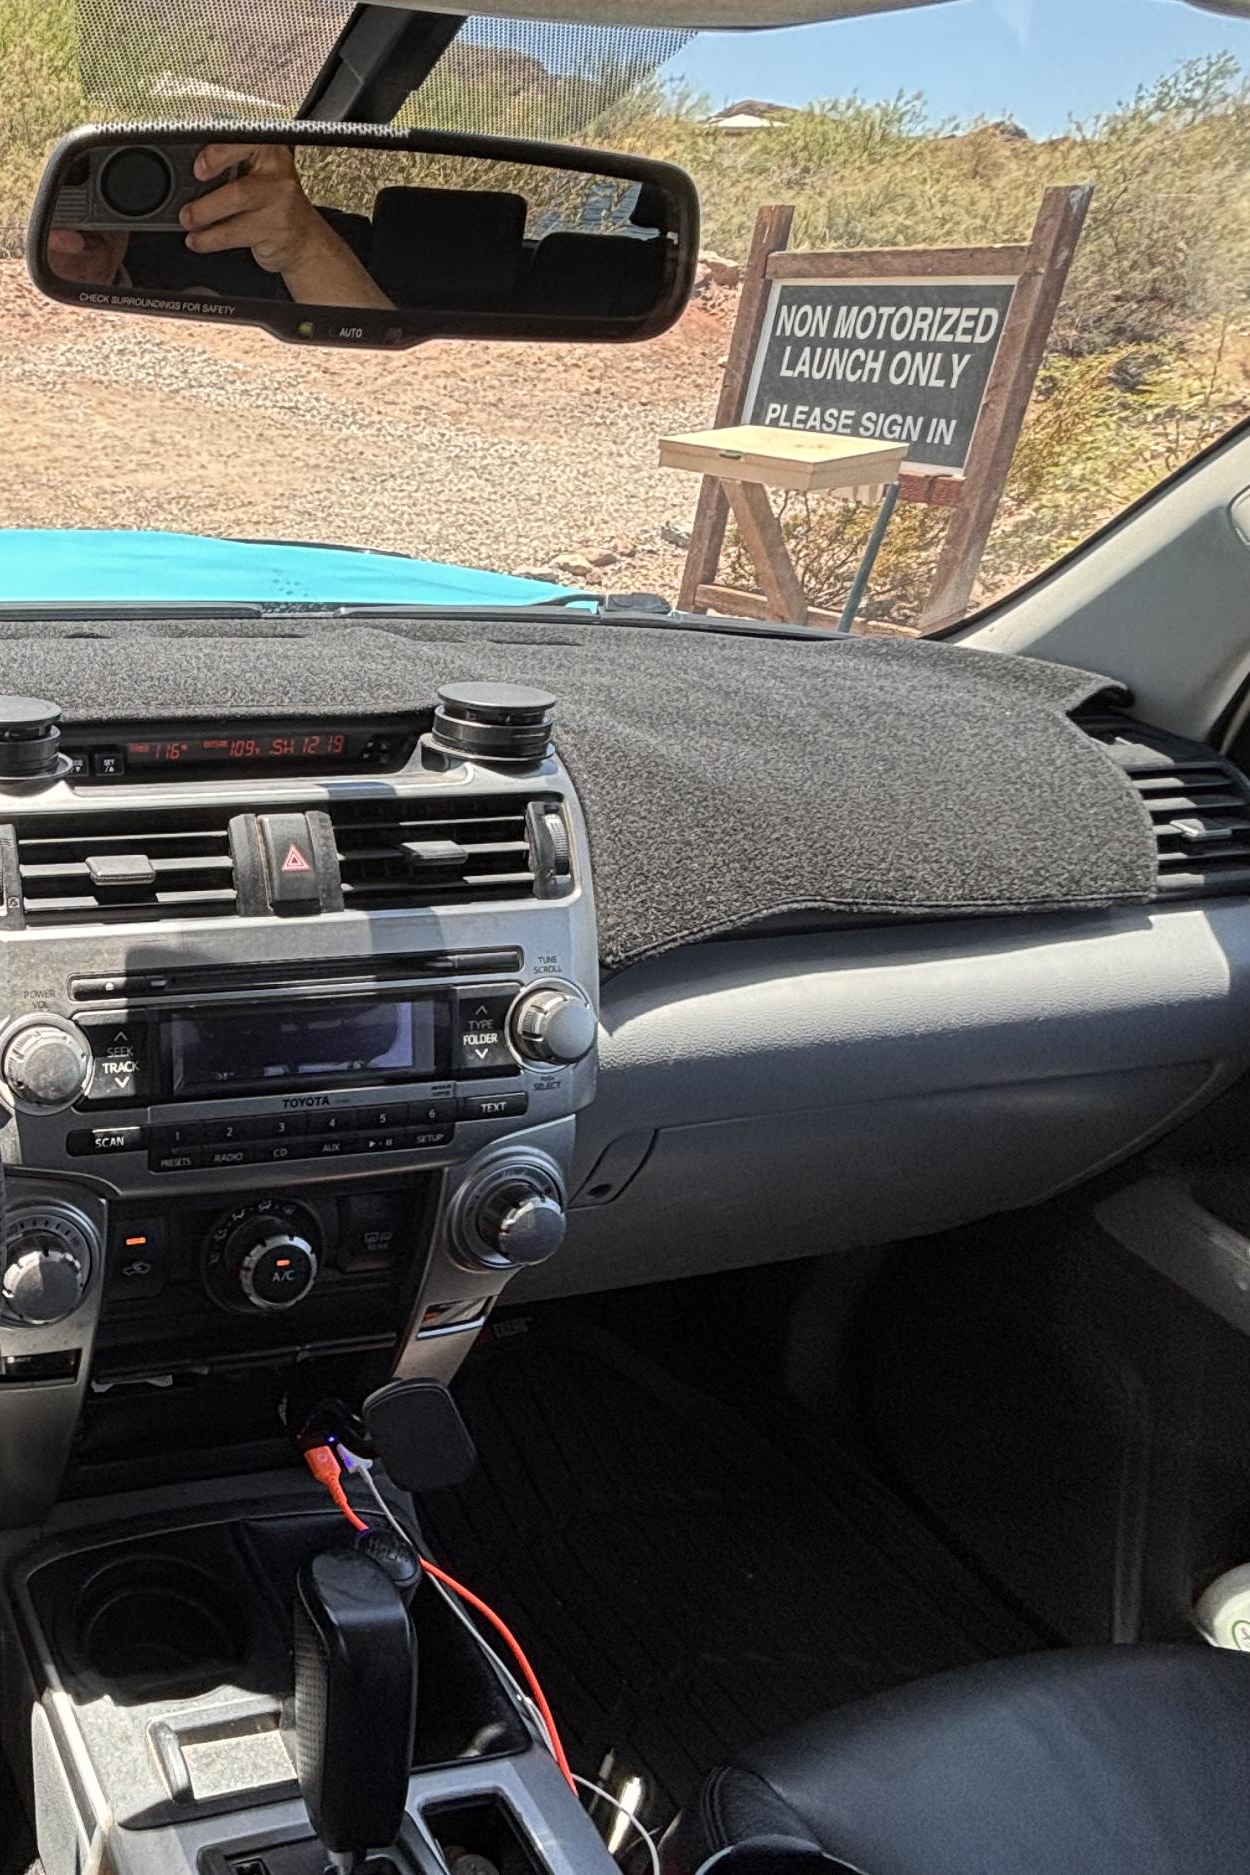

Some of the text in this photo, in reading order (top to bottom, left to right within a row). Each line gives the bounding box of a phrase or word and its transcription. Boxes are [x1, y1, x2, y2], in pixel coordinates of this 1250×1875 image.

[79, 292, 236, 315] CHECK SURROUNDINGS FOR SAFETY
[775, 304, 999, 344] NON MOTORIZED
[339, 327, 363, 338] AUTO
[779, 346, 973, 389] LAUNCH ONLY
[765, 402, 958, 446] PLEASE SIGN IN
[537, 955, 559, 965] TUNE
[533, 964, 563, 975] SCROLL
[23, 989, 57, 999] POWER
[32, 1000, 49, 1010] VOL
[468, 1018, 494, 1030] TYPE
[462, 1033, 499, 1046] FOLDER
[106, 1045, 134, 1058] SEEK
[102, 1060, 140, 1075] TRACK
[533, 1080, 562, 1091] SELECT
[282, 1095, 330, 1110] TOYOTA
[480, 1102, 508, 1113] TEXT
[379, 1113, 387, 1124] 5
[428, 1108, 436, 1119] 6
[278, 1122, 286, 1132] 3
[327, 1118, 336, 1128] 4
[226, 1127, 234, 1137] 2
[94, 1136, 125, 1149] SCAN
[416, 1133, 445, 1144] SETUP
[273, 1147, 288, 1158] CD
[321, 1143, 341, 1152] AUX
[160, 1157, 192, 1168] PRESETS
[214, 1152, 244, 1163] RADIO
[271, 1269, 295, 1283] A/C
